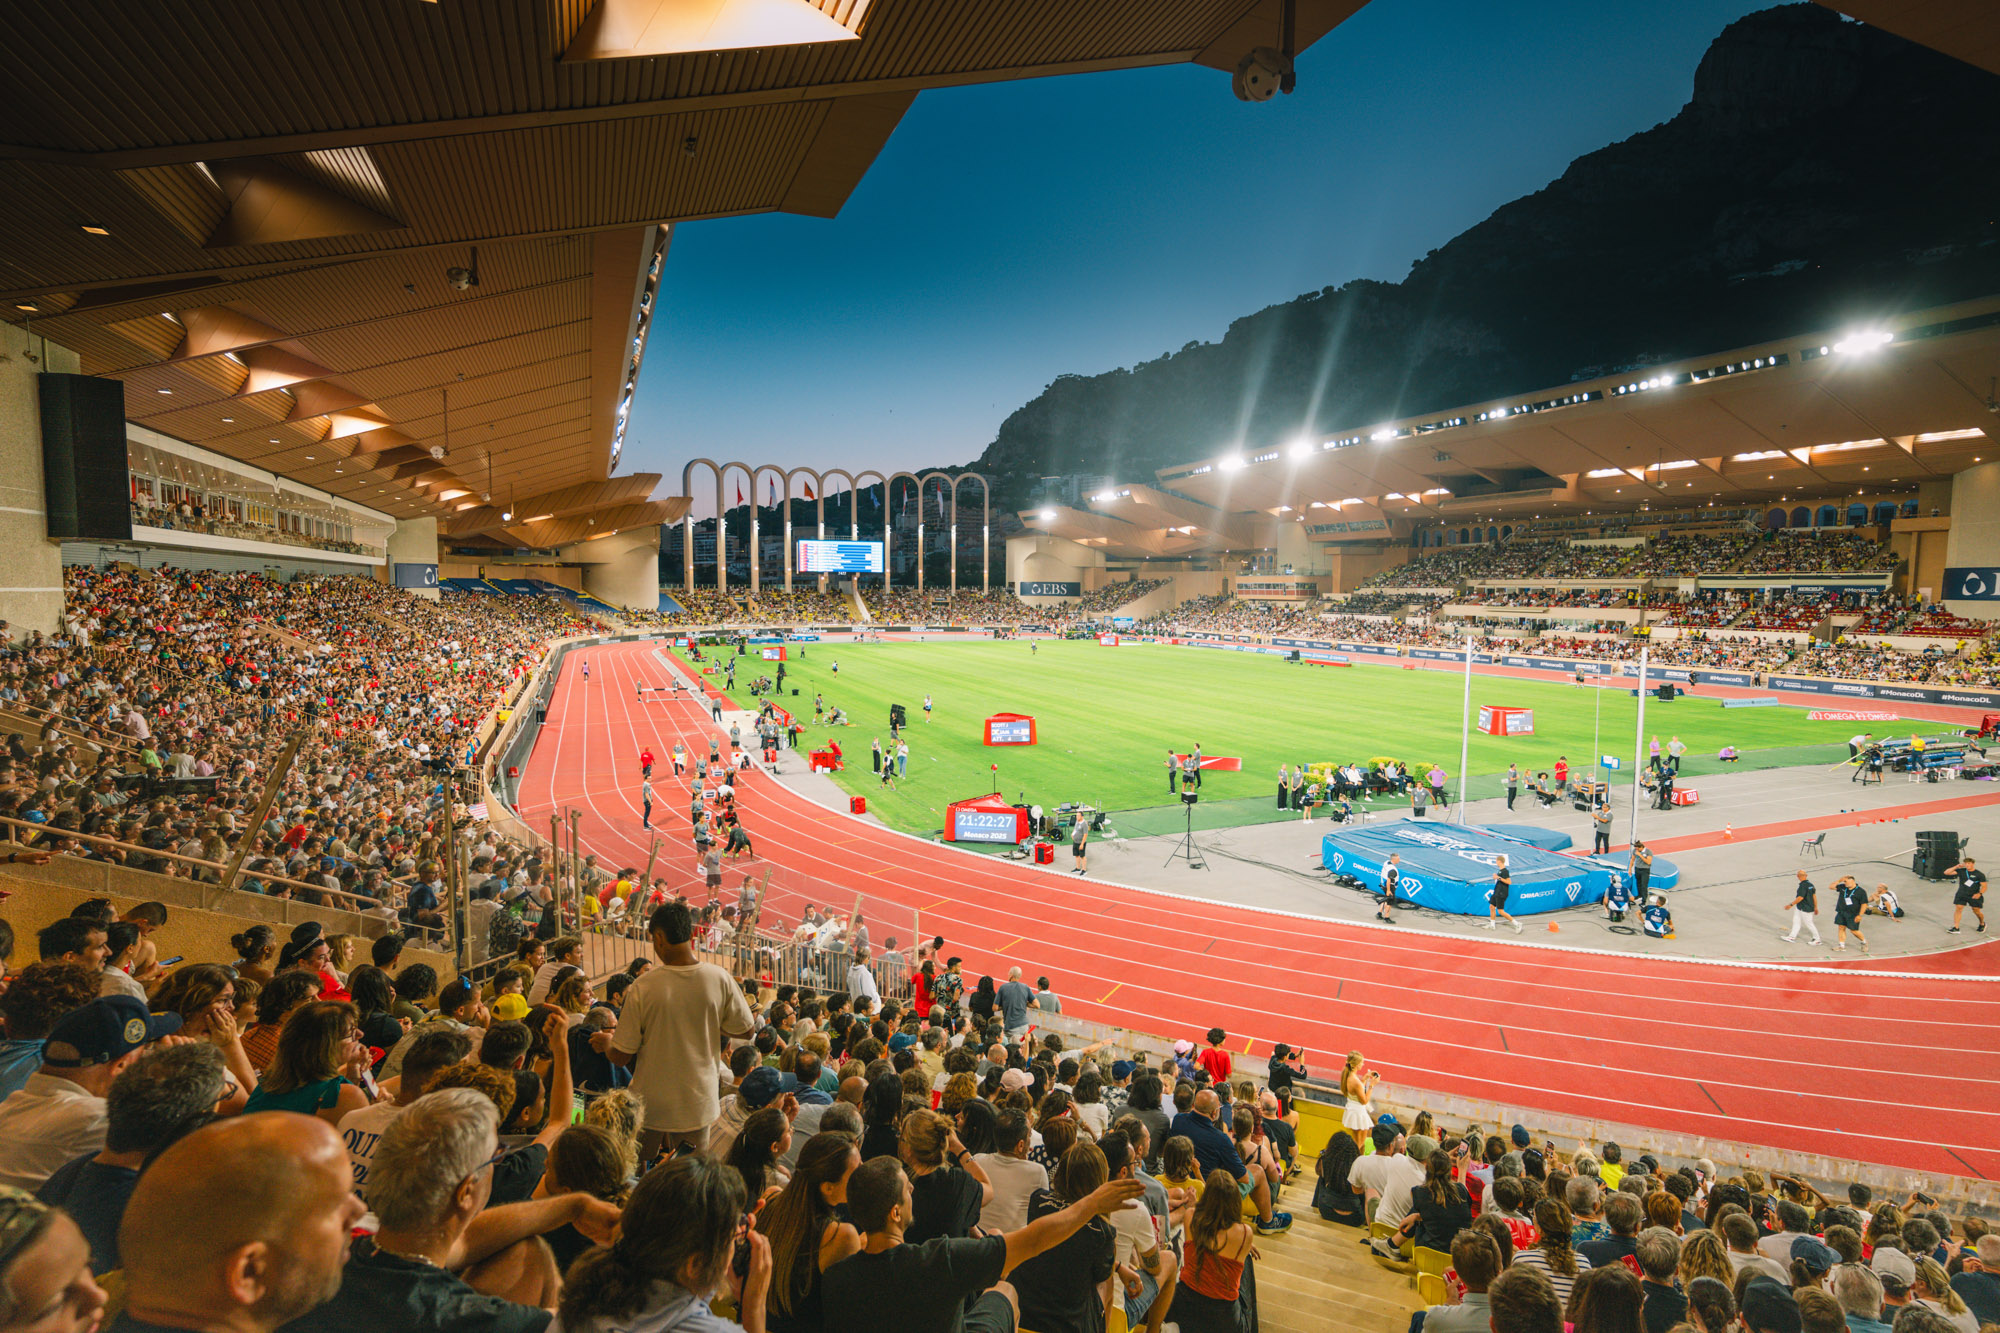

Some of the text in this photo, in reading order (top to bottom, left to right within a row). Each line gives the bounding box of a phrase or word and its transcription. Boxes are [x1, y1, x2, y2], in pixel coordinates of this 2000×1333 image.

[1043, 583, 1067, 595] EBS
[1709, 675, 1744, 683] #MonacoDL
[1880, 689, 1926, 699] #MonacoDL
[1941, 694, 1992, 704] #MonacoDL
[1824, 712, 1856, 720] OMEGA
[958, 814, 1013, 828] 21:22:27
[963, 831, 1007, 840] Monaco 2025
[1519, 889, 1556, 899] DIMASPORT
